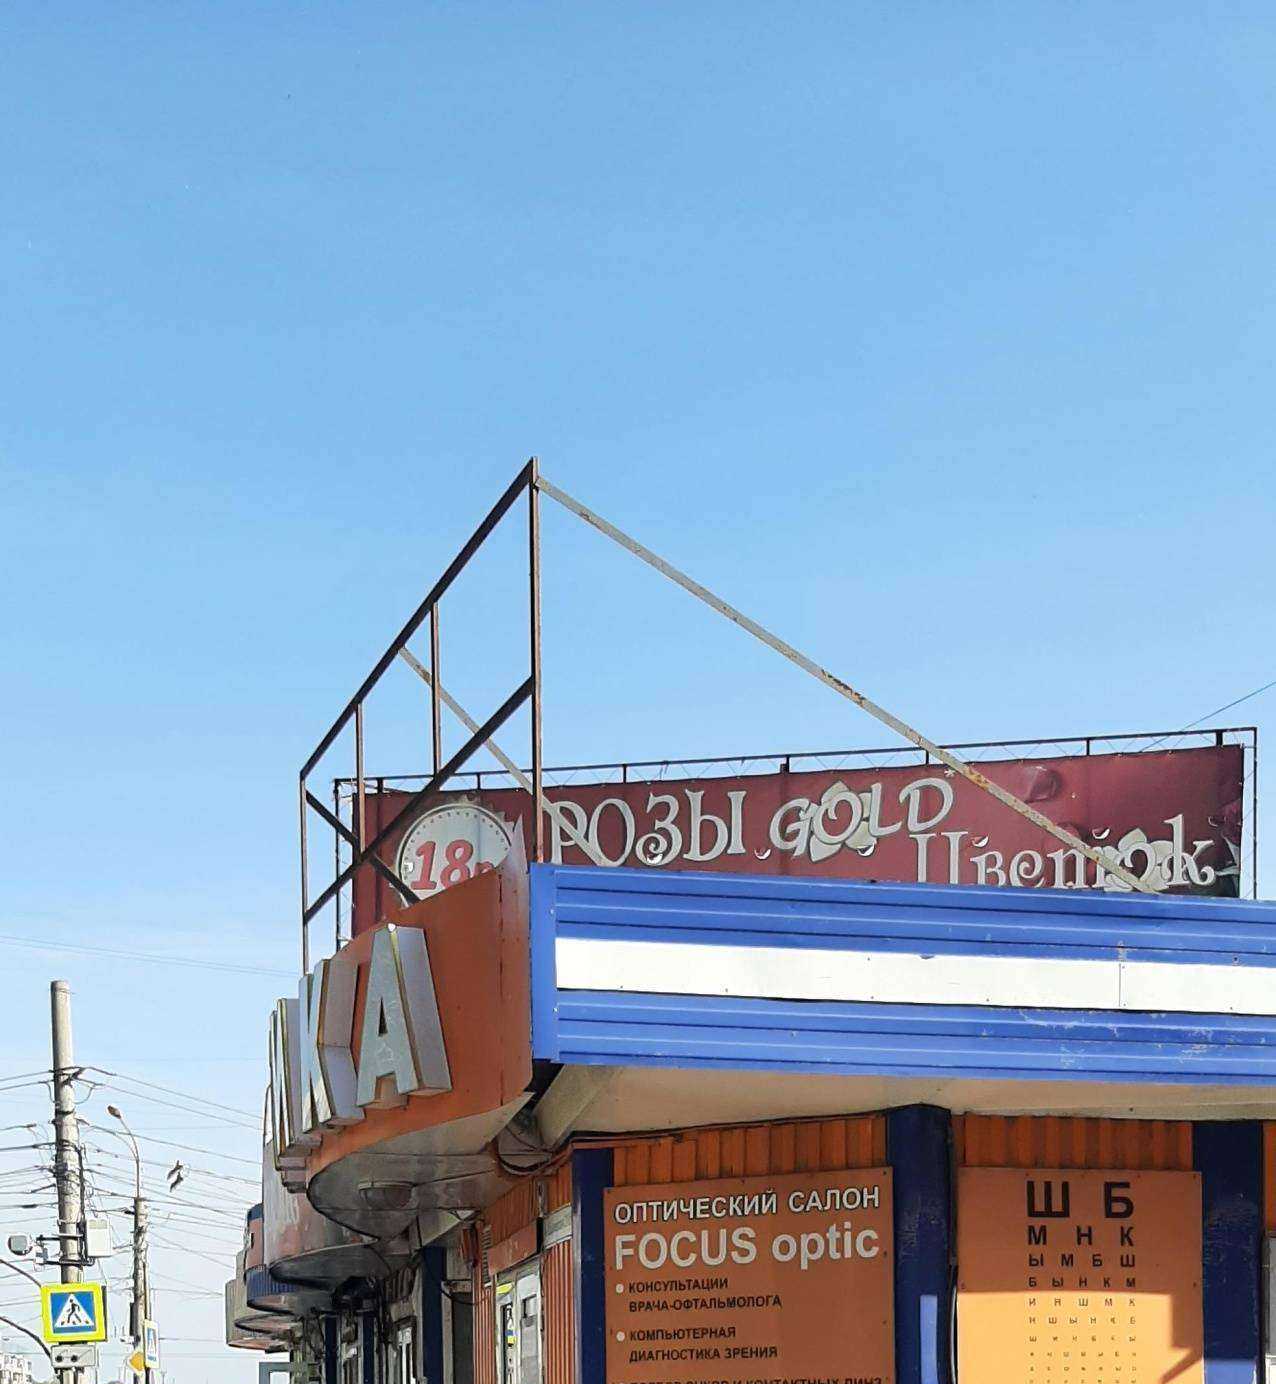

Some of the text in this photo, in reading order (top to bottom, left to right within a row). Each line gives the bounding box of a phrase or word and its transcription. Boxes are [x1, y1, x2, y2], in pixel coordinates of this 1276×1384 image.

[546, 788, 746, 867] РОЗЫ
[614, 1186, 880, 1224] ОПТИЧЕСКИЙ САЛОН
[1026, 1180, 1134, 1219] Ш Б
[1028, 1225, 1134, 1247] М Н К
[615, 1222, 880, 1270] FOCUS optic
[1029, 1254, 1136, 1267] Ы М Б Ш
[629, 1278, 728, 1293] КОНСУЛЬТАЦИИ
[1029, 1277, 1136, 1288] Б Ы Н К М
[629, 1294, 782, 1312] ВРАЧА-ОФТАЛЬМОЛОГА
[629, 1326, 736, 1342] КОМПЬЮТЕРНАЯ
[629, 1346, 778, 1364] ДИАГНОСТИКА ЗРЕНИЯ
